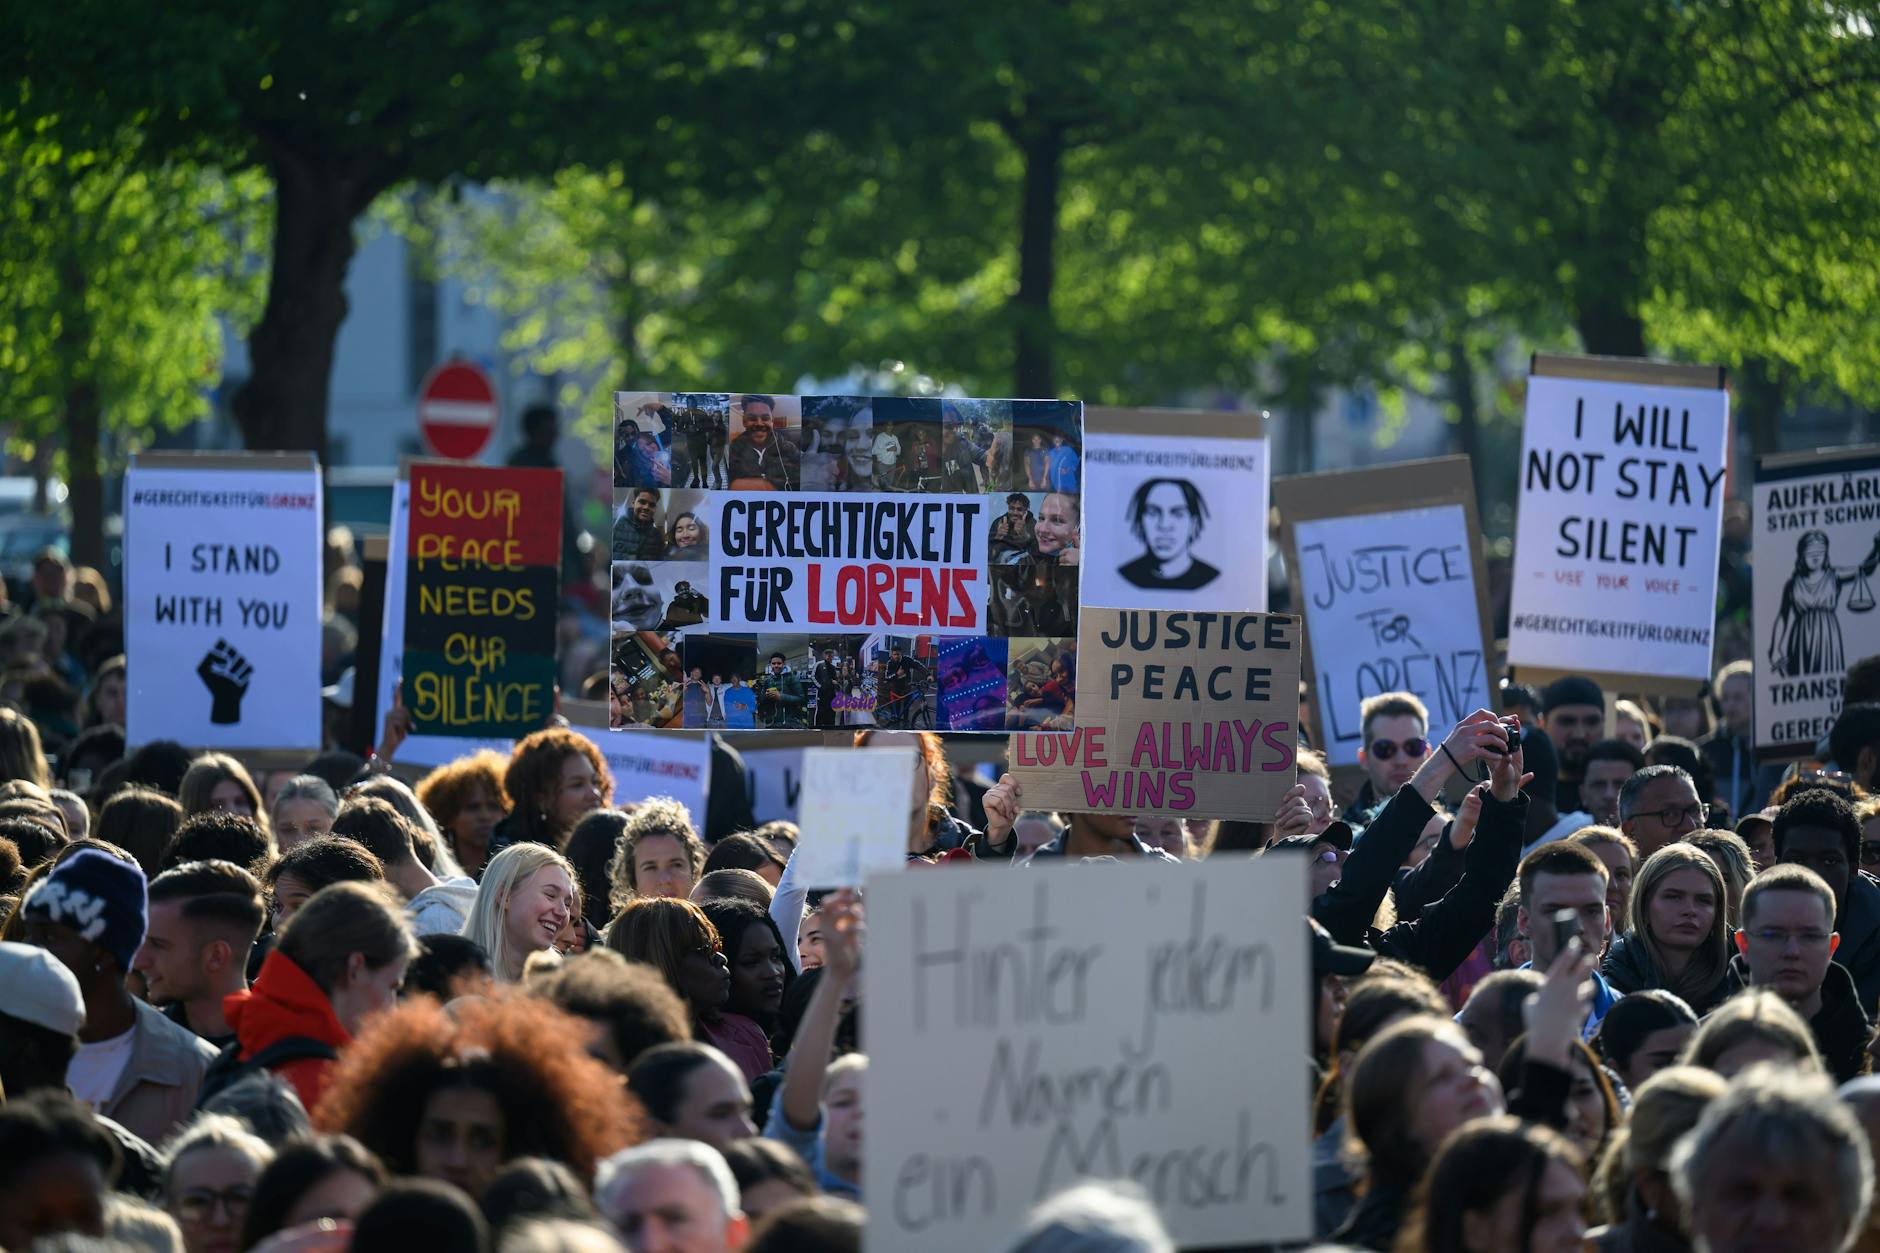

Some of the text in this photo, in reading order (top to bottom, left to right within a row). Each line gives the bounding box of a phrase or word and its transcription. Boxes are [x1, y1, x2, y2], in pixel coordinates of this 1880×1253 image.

[1575, 398, 1698, 452] I WILL
[1526, 449, 1726, 509] NOT STAY
[419, 477, 520, 537] YOUR
[720, 500, 980, 564] GERECHTIGKEIT
[1767, 503, 1880, 532] STATT SCHW
[165, 542, 280, 575] I STAND
[417, 533, 525, 572] PEACE
[1556, 516, 1697, 568] SILENT
[720, 566, 794, 624] FÜR
[1302, 542, 1468, 611] JUSTICE
[1554, 570, 1680, 594] USE YOUR VOICE
[156, 594, 288, 630] WITH YOU
[419, 585, 536, 621] NEEDS
[1355, 607, 1423, 649] FOR
[1101, 611, 1292, 651] JUSTICE
[1514, 614, 1711, 648] #GERECHTIGKEITFÜRLORENZ
[444, 632, 507, 683] OUR
[1110, 664, 1272, 701] PEACE
[413, 670, 542, 726] SILENCE
[1017, 719, 1293, 773] LOVE ALWAYS
[1081, 770, 1196, 810] WINS
[911, 876, 1277, 1062] Hinter jedem
[977, 1037, 1172, 1132] Namen
[893, 1108, 998, 1233] ein
